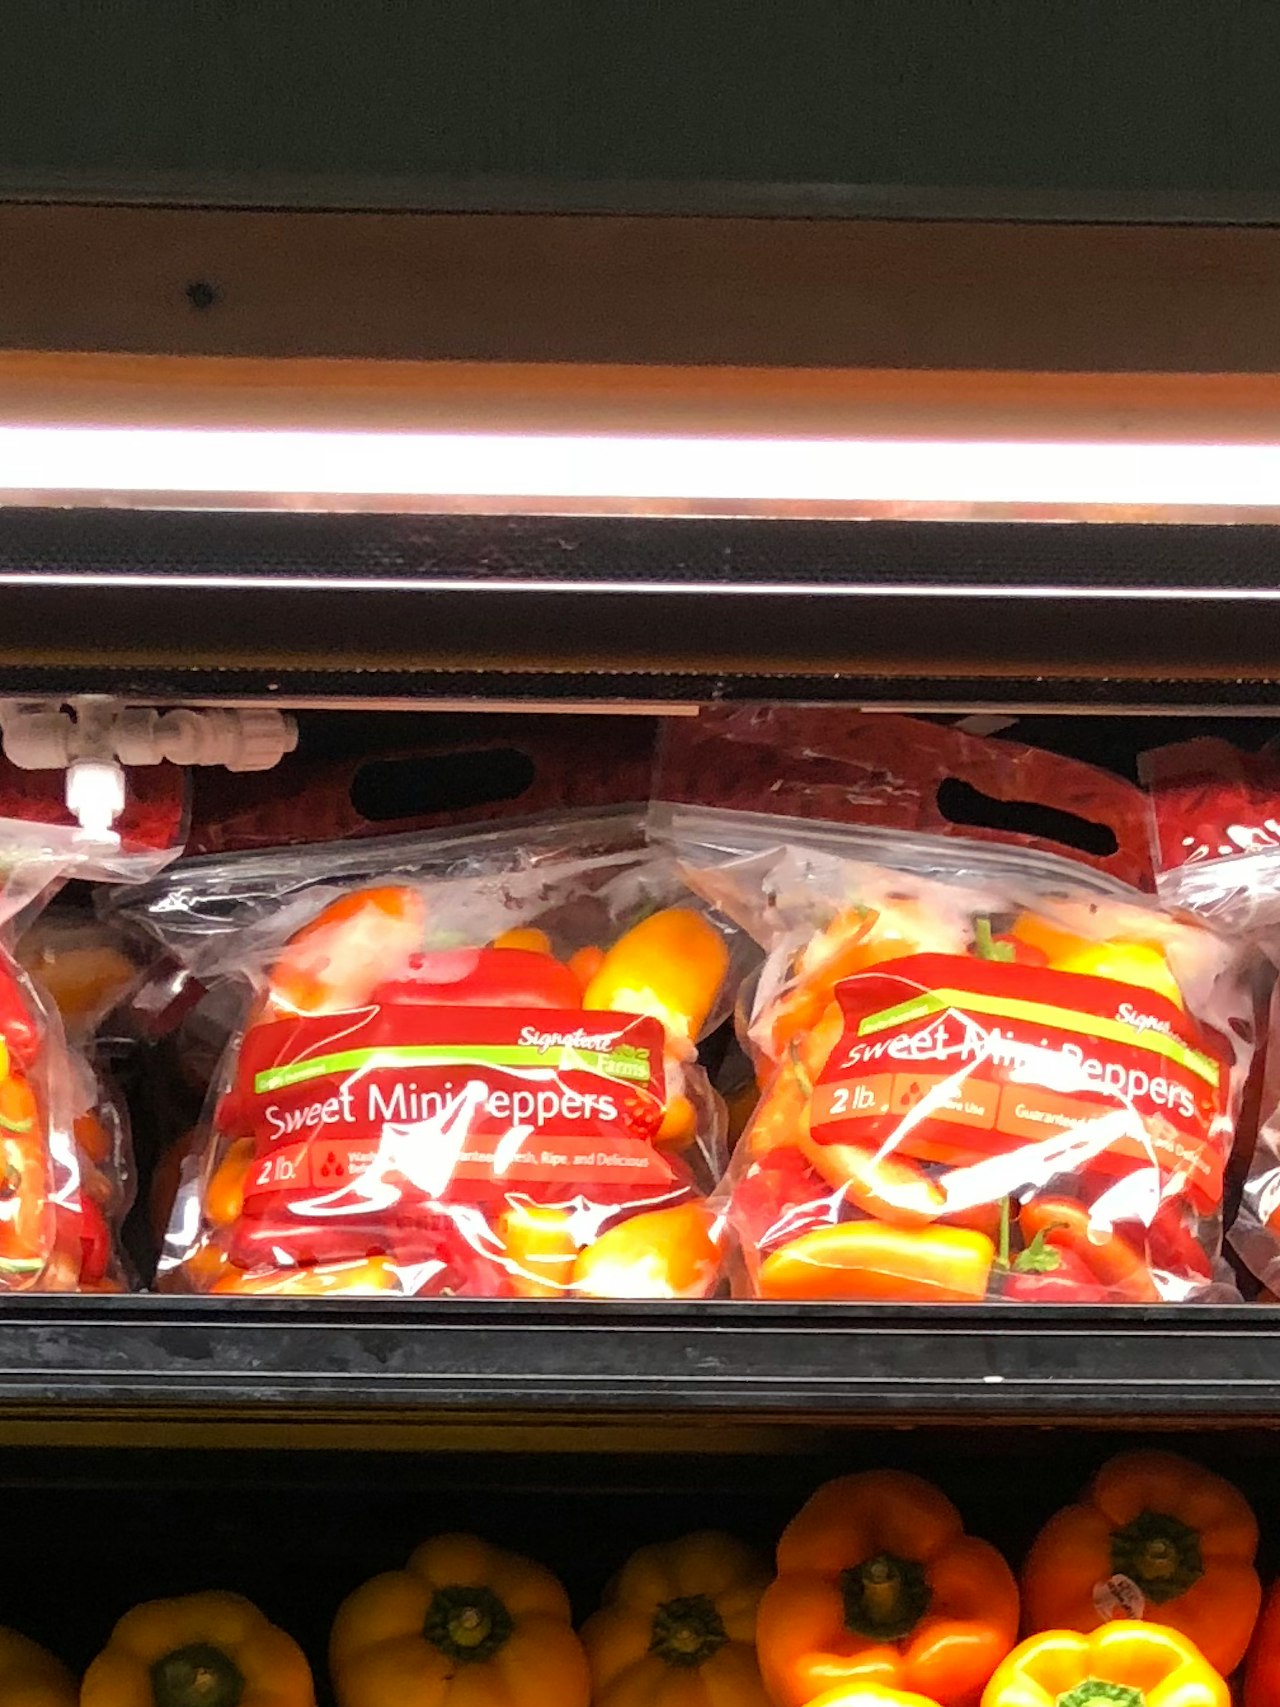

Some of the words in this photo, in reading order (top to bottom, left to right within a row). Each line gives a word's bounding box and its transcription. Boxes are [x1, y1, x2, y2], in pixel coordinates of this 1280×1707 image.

[829, 1088, 848, 1114] 2
[852, 1085, 876, 1110] lb.
[1061, 1043, 1196, 1118] Peppers
[265, 1089, 355, 1140] Sweet
[484, 1088, 618, 1126] eppers
[256, 1160, 270, 1185] 2
[273, 1157, 296, 1181] lb.
